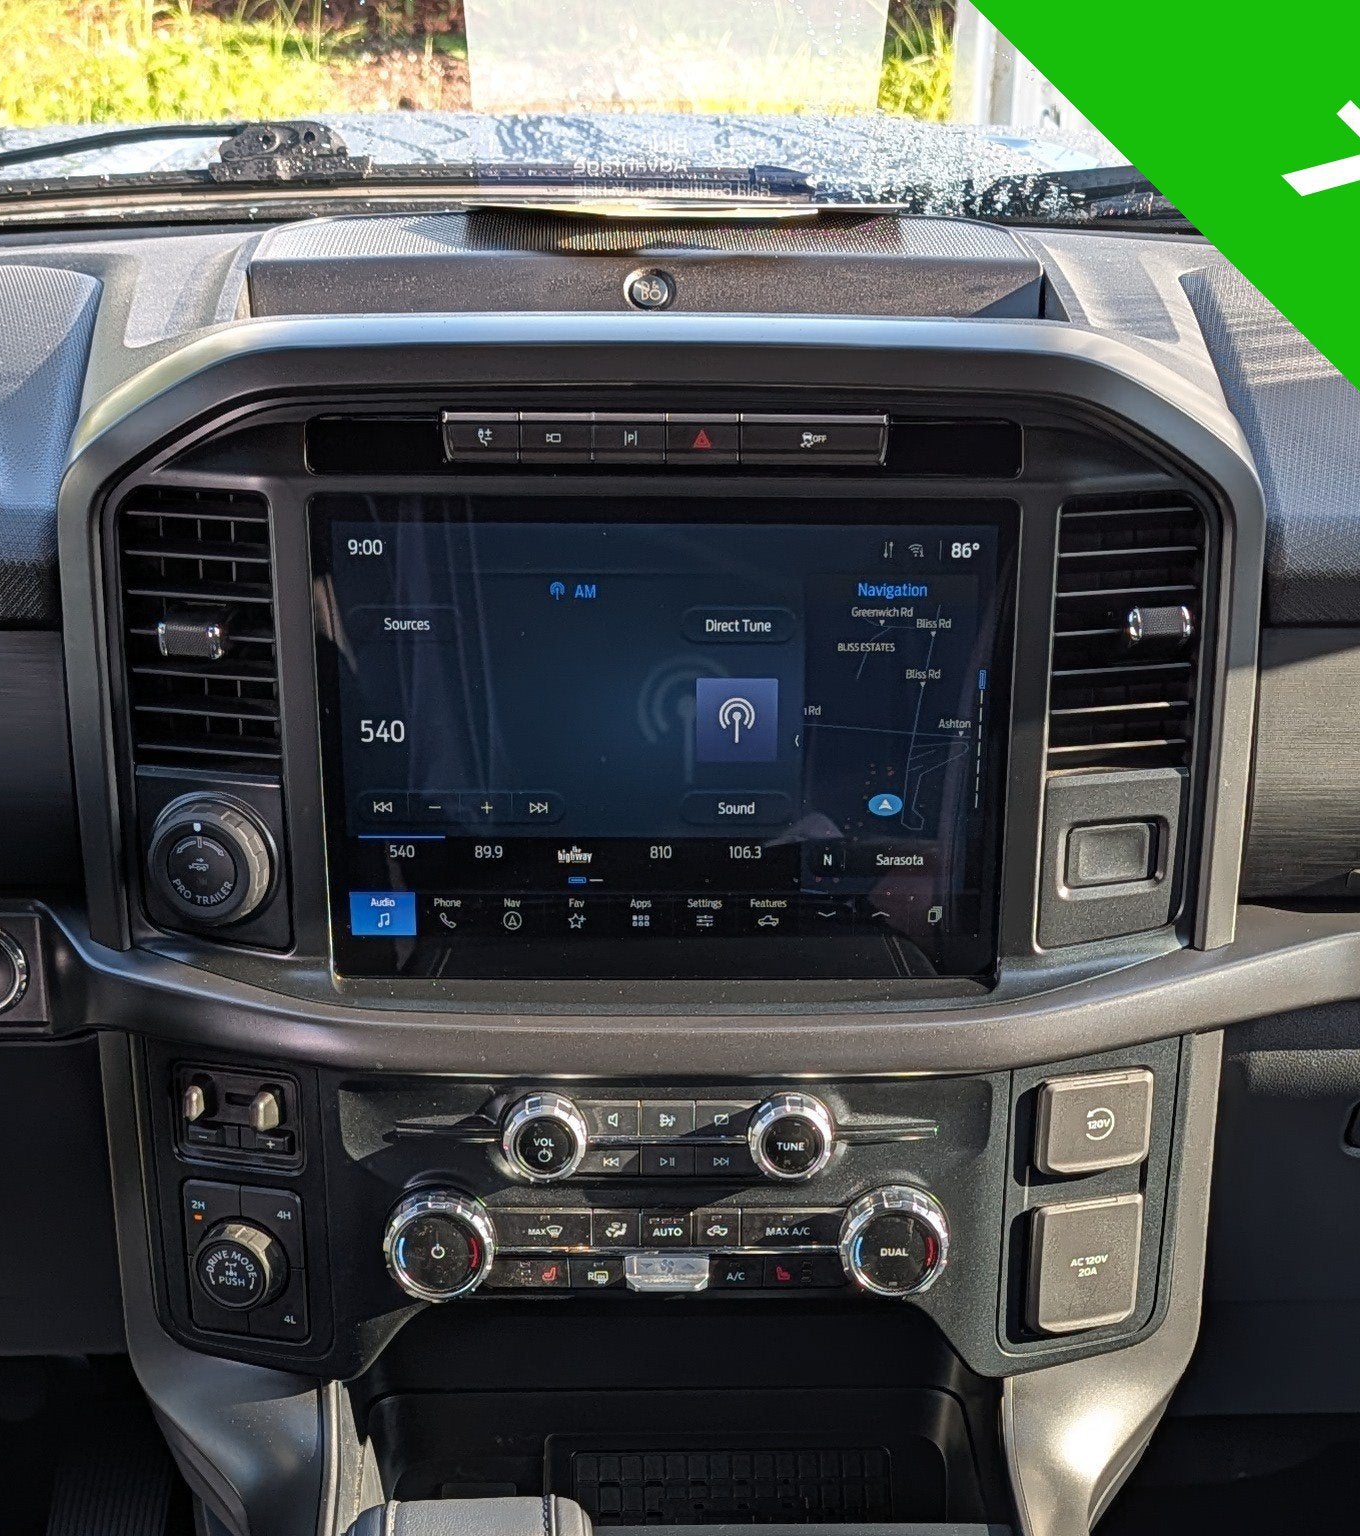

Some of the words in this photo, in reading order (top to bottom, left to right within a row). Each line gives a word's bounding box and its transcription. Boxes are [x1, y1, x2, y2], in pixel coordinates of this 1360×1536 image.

[812, 434, 828, 443] OFF
[347, 539, 383, 555] 9:00
[951, 542, 980, 559] 86°
[574, 584, 597, 598] AM
[857, 582, 928, 600] Navigation
[851, 606, 900, 618] Greenwich
[900, 606, 914, 618] Rd
[384, 617, 430, 631] Sources
[705, 619, 740, 632] Direct
[742, 619, 772, 632] Tune
[916, 618, 937, 629] Bliss
[938, 618, 952, 629] Rd
[837, 642, 860, 653] BLISS
[860, 642, 896, 653] ESTATES
[905, 669, 927, 679] Bliss
[928, 668, 941, 679] Rd
[808, 705, 822, 716] Rd
[938, 719, 972, 729] Ashton
[360, 719, 405, 743] 540
[718, 802, 755, 815] Sound
[389, 845, 415, 859] 540
[474, 845, 503, 859] 89.9
[649, 845, 672, 859] 810
[729, 845, 762, 860] 106.3
[823, 854, 832, 867] N
[875, 854, 924, 867] Sarasota
[173, 879, 192, 899] PRO
[195, 881, 233, 905] TRAILER
[370, 897, 396, 908] Audio
[433, 897, 461, 908] Phone
[503, 897, 521, 908] Nav
[568, 897, 585, 908] Fav
[630, 898, 652, 910] Apps
[687, 898, 723, 910] Settings
[750, 898, 787, 909] Features
[1086, 1117, 1111, 1130] 120V
[533, 1137, 555, 1147] VOL
[776, 1141, 805, 1151] TUNE
[191, 1200, 206, 1210] 2H
[276, 1210, 292, 1220] 4H
[527, 1227, 546, 1236] MAX
[652, 1227, 683, 1238] AUTO
[765, 1227, 789, 1236] MAX
[791, 1226, 811, 1236] A/C
[880, 1247, 909, 1257] DUAL
[205, 1249, 230, 1274] DRIVE
[231, 1250, 258, 1279] MODE
[1070, 1257, 1084, 1267] AC
[1084, 1254, 1109, 1266] 120V
[726, 1271, 745, 1281] A/C
[1077, 1266, 1098, 1278] 20A
[219, 1276, 246, 1287] PUSH
[283, 1315, 297, 1325] 4L
